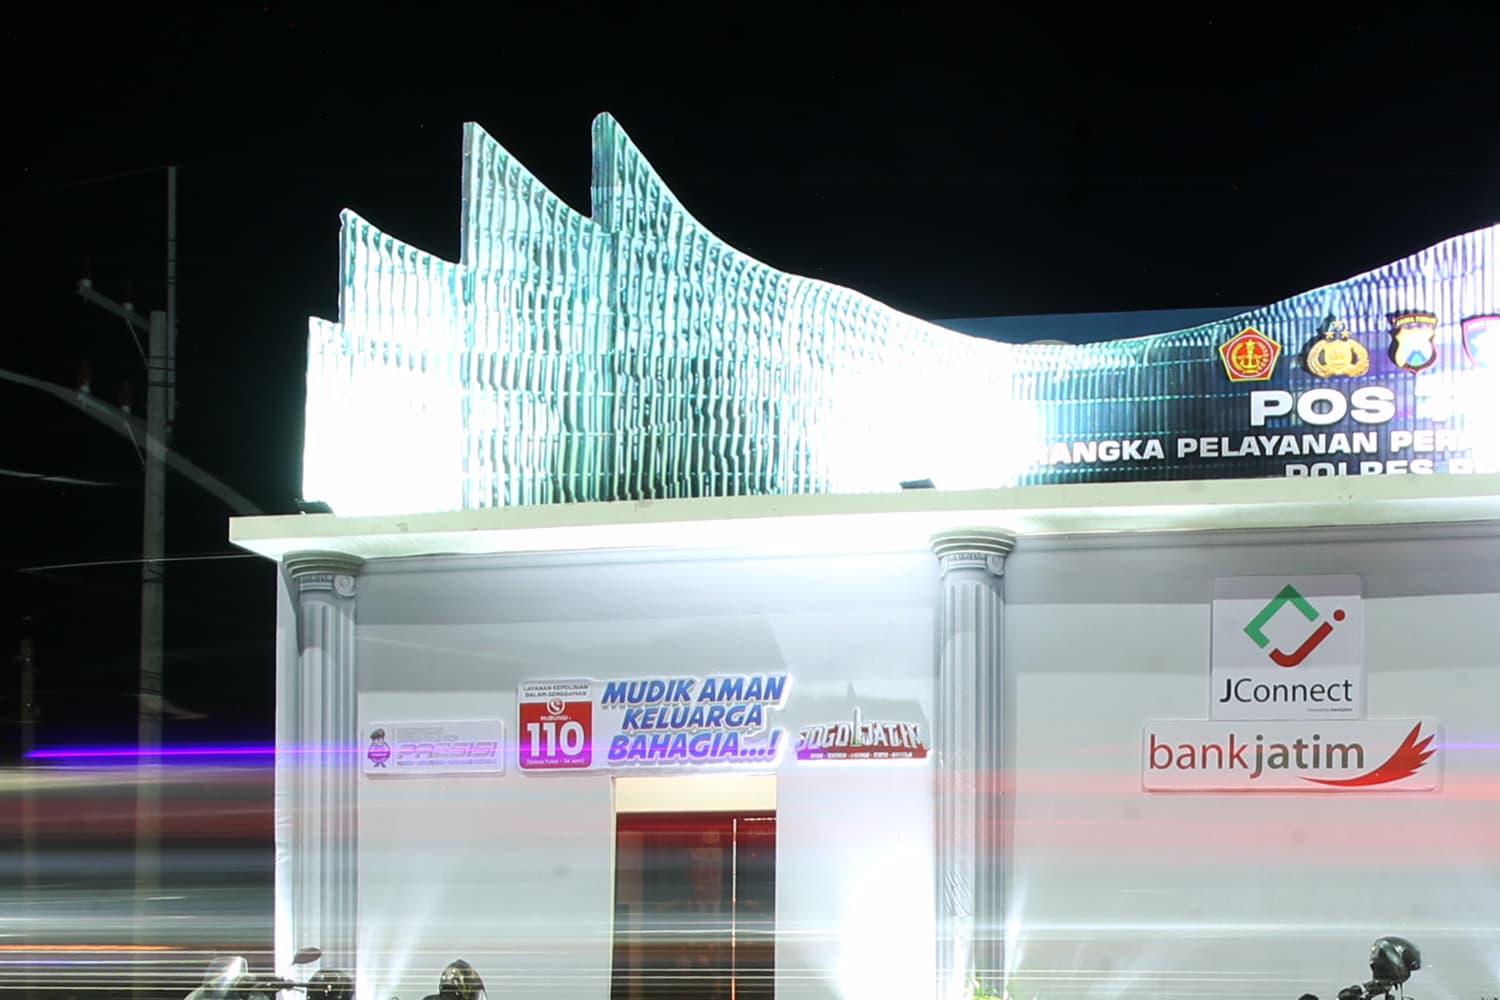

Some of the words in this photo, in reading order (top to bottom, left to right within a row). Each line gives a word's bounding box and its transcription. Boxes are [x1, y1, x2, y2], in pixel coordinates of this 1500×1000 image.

[1250, 386, 1396, 426] POS
[1177, 431, 1378, 458] PELAYANAN
[602, 679, 694, 705] MUDIK
[697, 675, 787, 703] AMAN
[1219, 678, 1353, 703] JConnect
[622, 703, 763, 731] KELUARGA
[527, 721, 585, 757] 110
